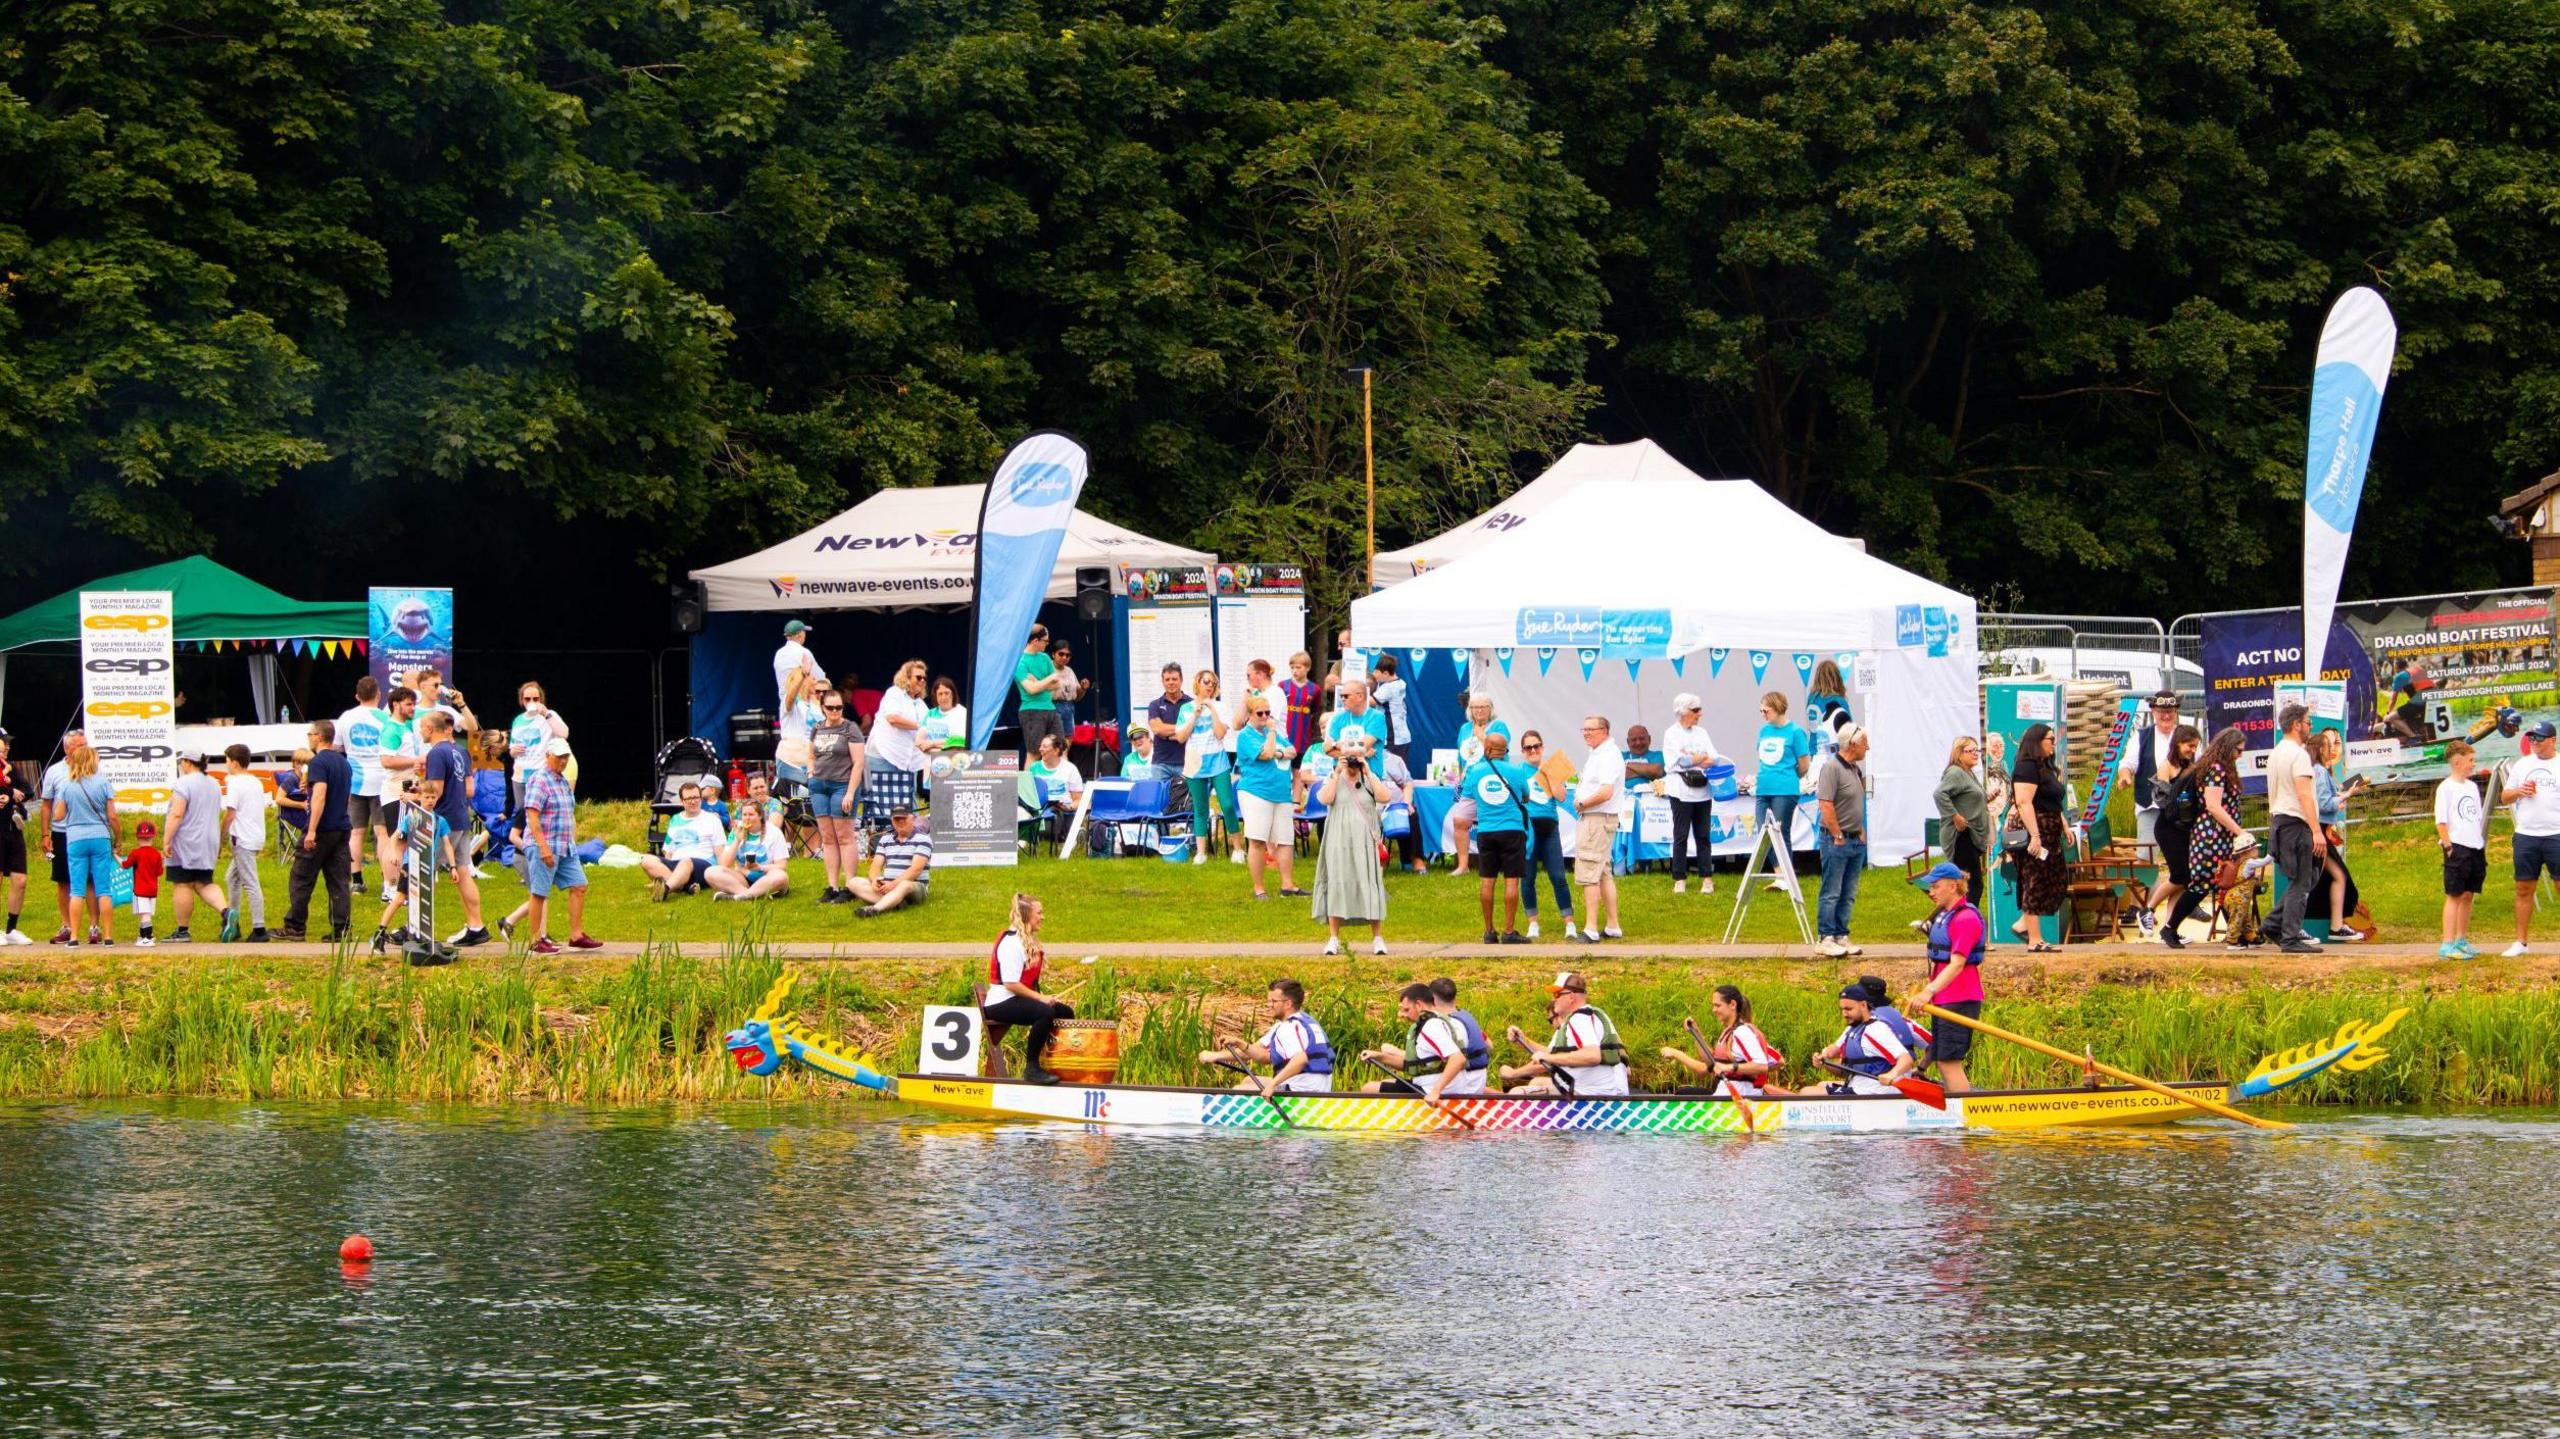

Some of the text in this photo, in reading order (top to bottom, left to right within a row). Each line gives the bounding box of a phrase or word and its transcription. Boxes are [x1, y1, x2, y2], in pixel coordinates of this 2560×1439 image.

[2322, 397, 2357, 496] Thorpe Hall
[2336, 442, 2360, 507] Hospice
[1184, 572, 1206, 585] 2024
[1279, 568, 1301, 579] 2024
[1279, 586, 1304, 594] FESTIVAL
[2512, 598, 2548, 607] OFFICIAL
[83, 615, 169, 633] esp
[1523, 609, 1600, 642] Sue Ryder
[1618, 625, 1664, 634] supporting
[1622, 636, 1647, 644] Ryder
[2374, 623, 2550, 649] DRAGON BOAT FESTIVAL
[2236, 647, 2302, 666] ACT NO
[2388, 650, 2396, 658] IN
[2411, 648, 2423, 656] OF
[2438, 643, 2464, 653] RYDER
[2464, 641, 2495, 651] THORPE
[2495, 640, 2516, 648] HALL
[2516, 637, 2550, 647] HOSPICE
[85, 658, 170, 676] esp
[388, 662, 433, 672] Monsters
[2319, 669, 2351, 682] DAY!
[2427, 660, 2550, 678] SATURDAY 22ND JUNE 2024
[2214, 677, 2256, 690] ENTER
[2257, 677, 2267, 687] A
[2421, 681, 2555, 700] PETERBOROUGH ROWING LAKE
[86, 702, 171, 719] esp
[2436, 705, 2450, 732] 5
[113, 788, 172, 806] sp
[931, 1011, 971, 1061] 3
[1800, 1104, 1852, 1114] INSTITUTE
[1967, 1095, 2181, 1115] www.newwave-events.co.uk
[1813, 1114, 1852, 1124] EXPORT
